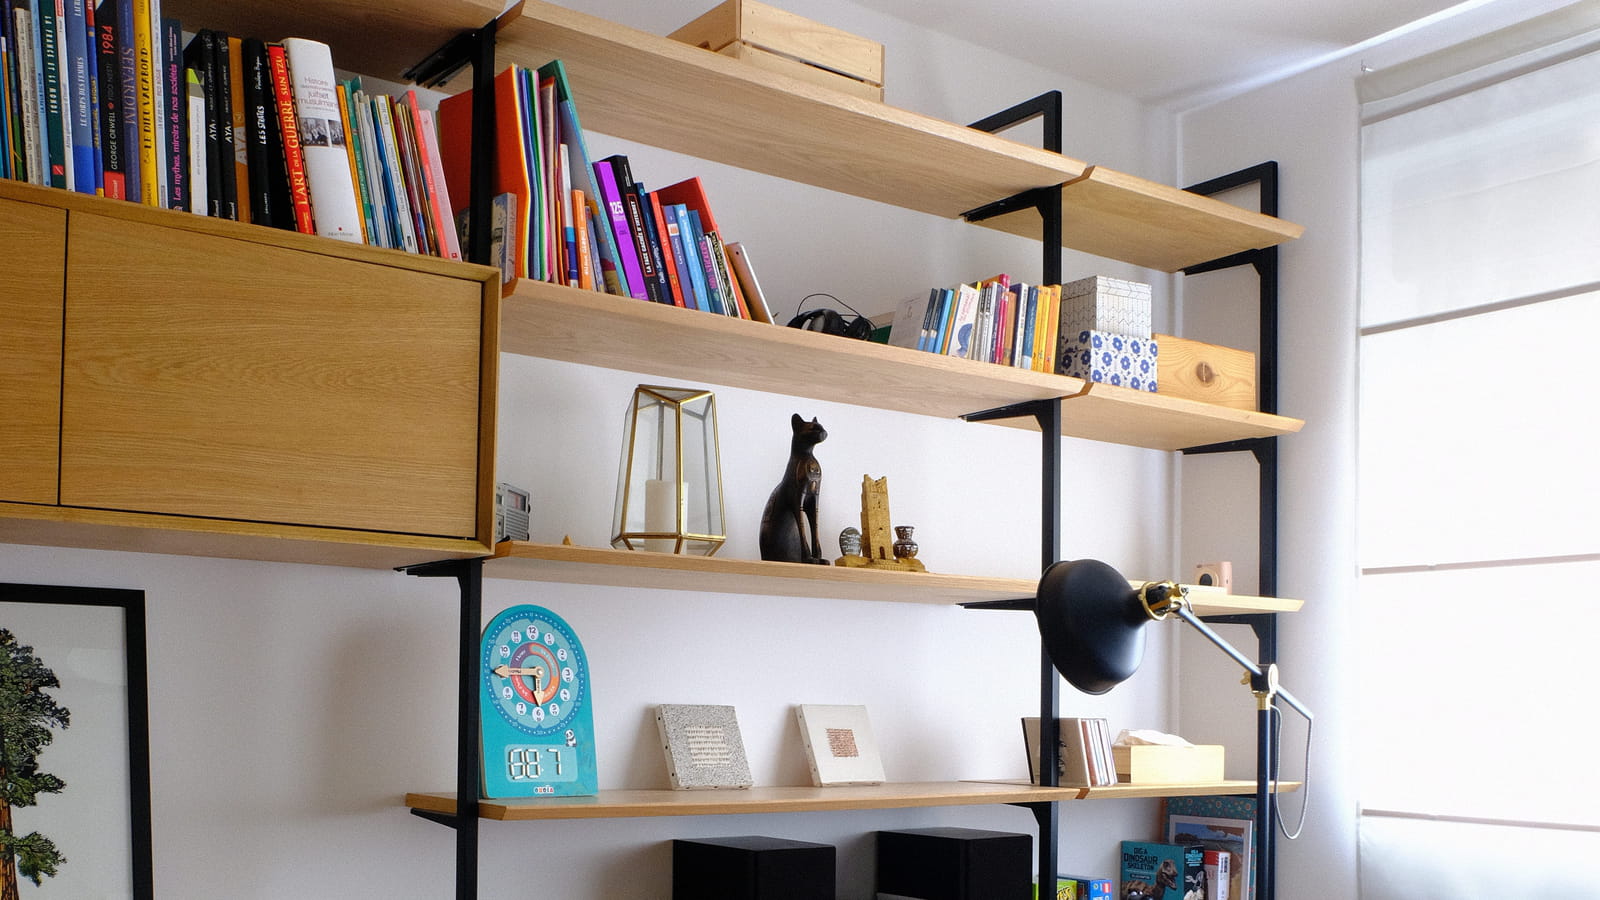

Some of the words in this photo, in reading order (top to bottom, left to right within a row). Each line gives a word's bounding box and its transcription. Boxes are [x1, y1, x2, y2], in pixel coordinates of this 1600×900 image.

[44, 16, 52, 24] LA
[45, 29, 54, 58] FRANCE
[102, 26, 114, 54] 1984
[48, 62, 55, 71] ET
[76, 57, 85, 82] FEMMES
[140, 47, 150, 106] VAGABOND
[276, 56, 284, 74] TZU
[122, 48, 136, 125] SEFARDIM
[169, 64, 178, 95] sociétés
[279, 76, 288, 95] SUN
[49, 88, 58, 114] MONDE
[80, 117, 87, 127] LE
[142, 111, 152, 132] DIEU
[171, 112, 178, 122] de
[256, 105, 266, 129] STRATES
[281, 100, 299, 148] GUERRE
[171, 124, 179, 152] miroirs
[209, 124, 217, 140] AYA
[292, 168, 308, 205] L'ART
[610, 201, 623, 214] 125
[1124, 853, 1158, 865] DINOSAUR
